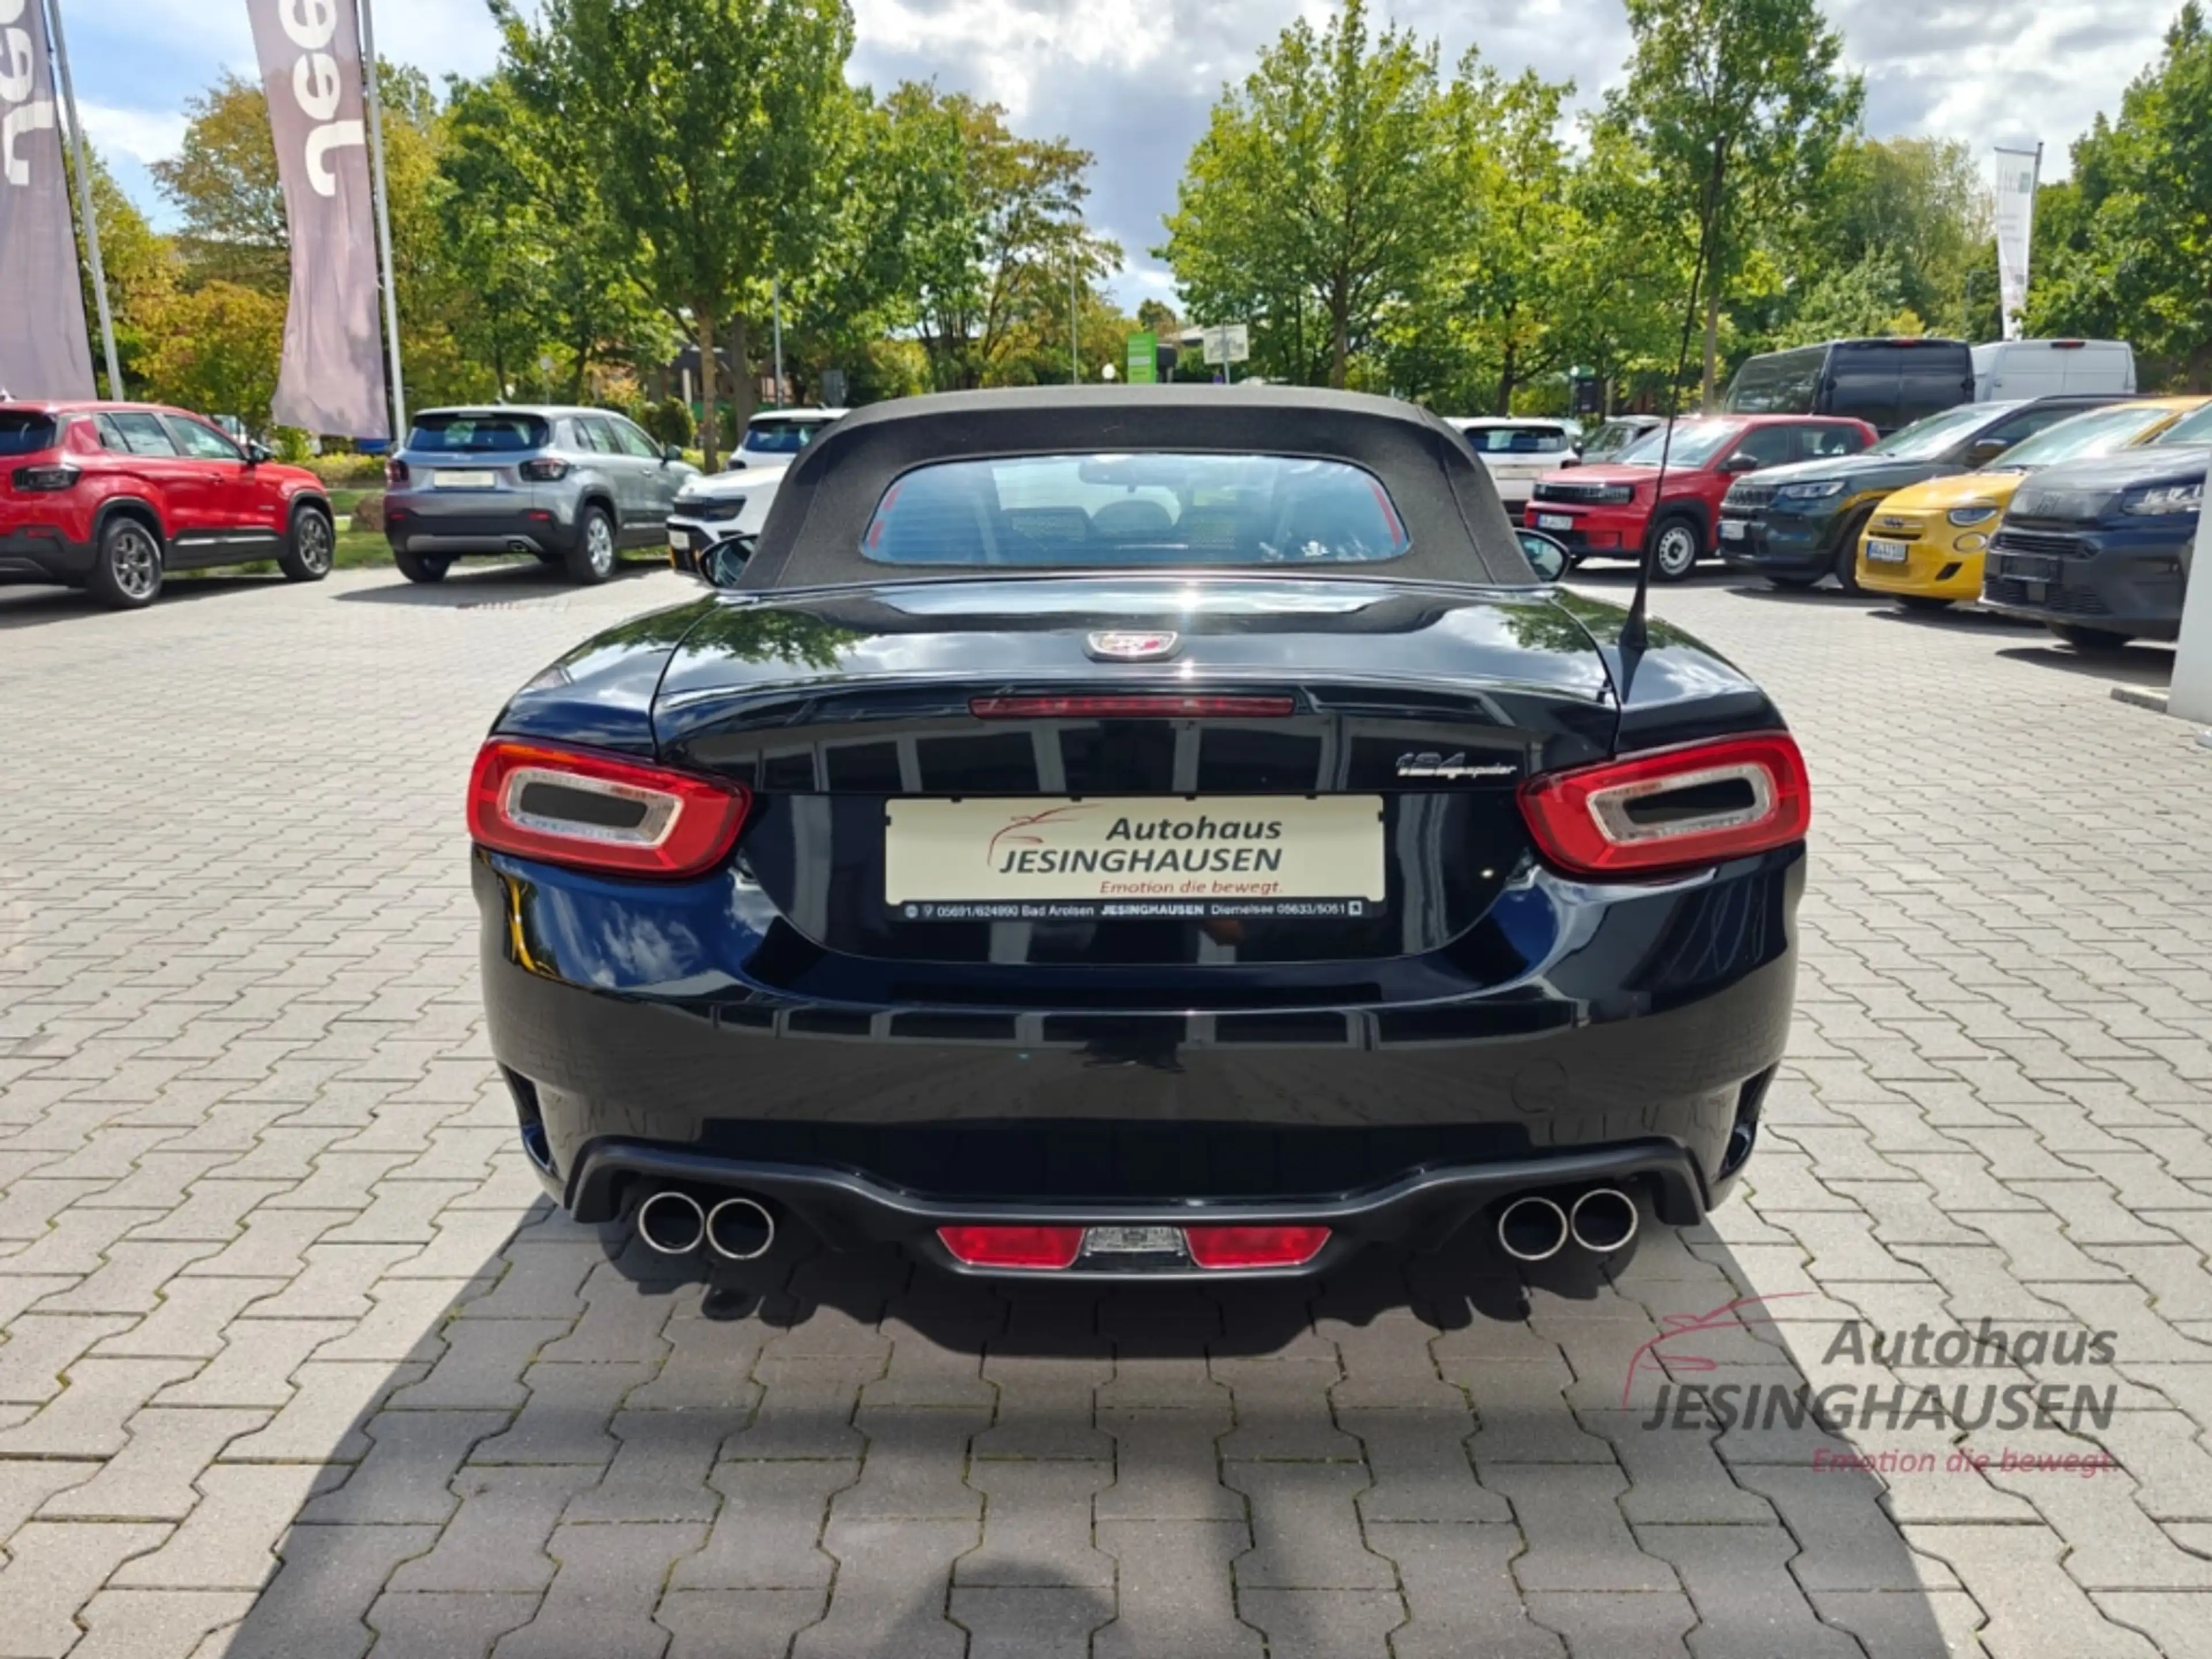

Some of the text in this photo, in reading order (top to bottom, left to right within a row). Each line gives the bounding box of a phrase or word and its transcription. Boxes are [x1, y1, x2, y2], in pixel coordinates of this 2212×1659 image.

[1105, 815, 1282, 841] Autohaus
[999, 848, 1282, 873] JESINGHAUSEN
[1099, 880, 1174, 893] Emotion
[1180, 880, 1206, 893] die
[1101, 904, 1205, 916] JESINGHAUSEN
